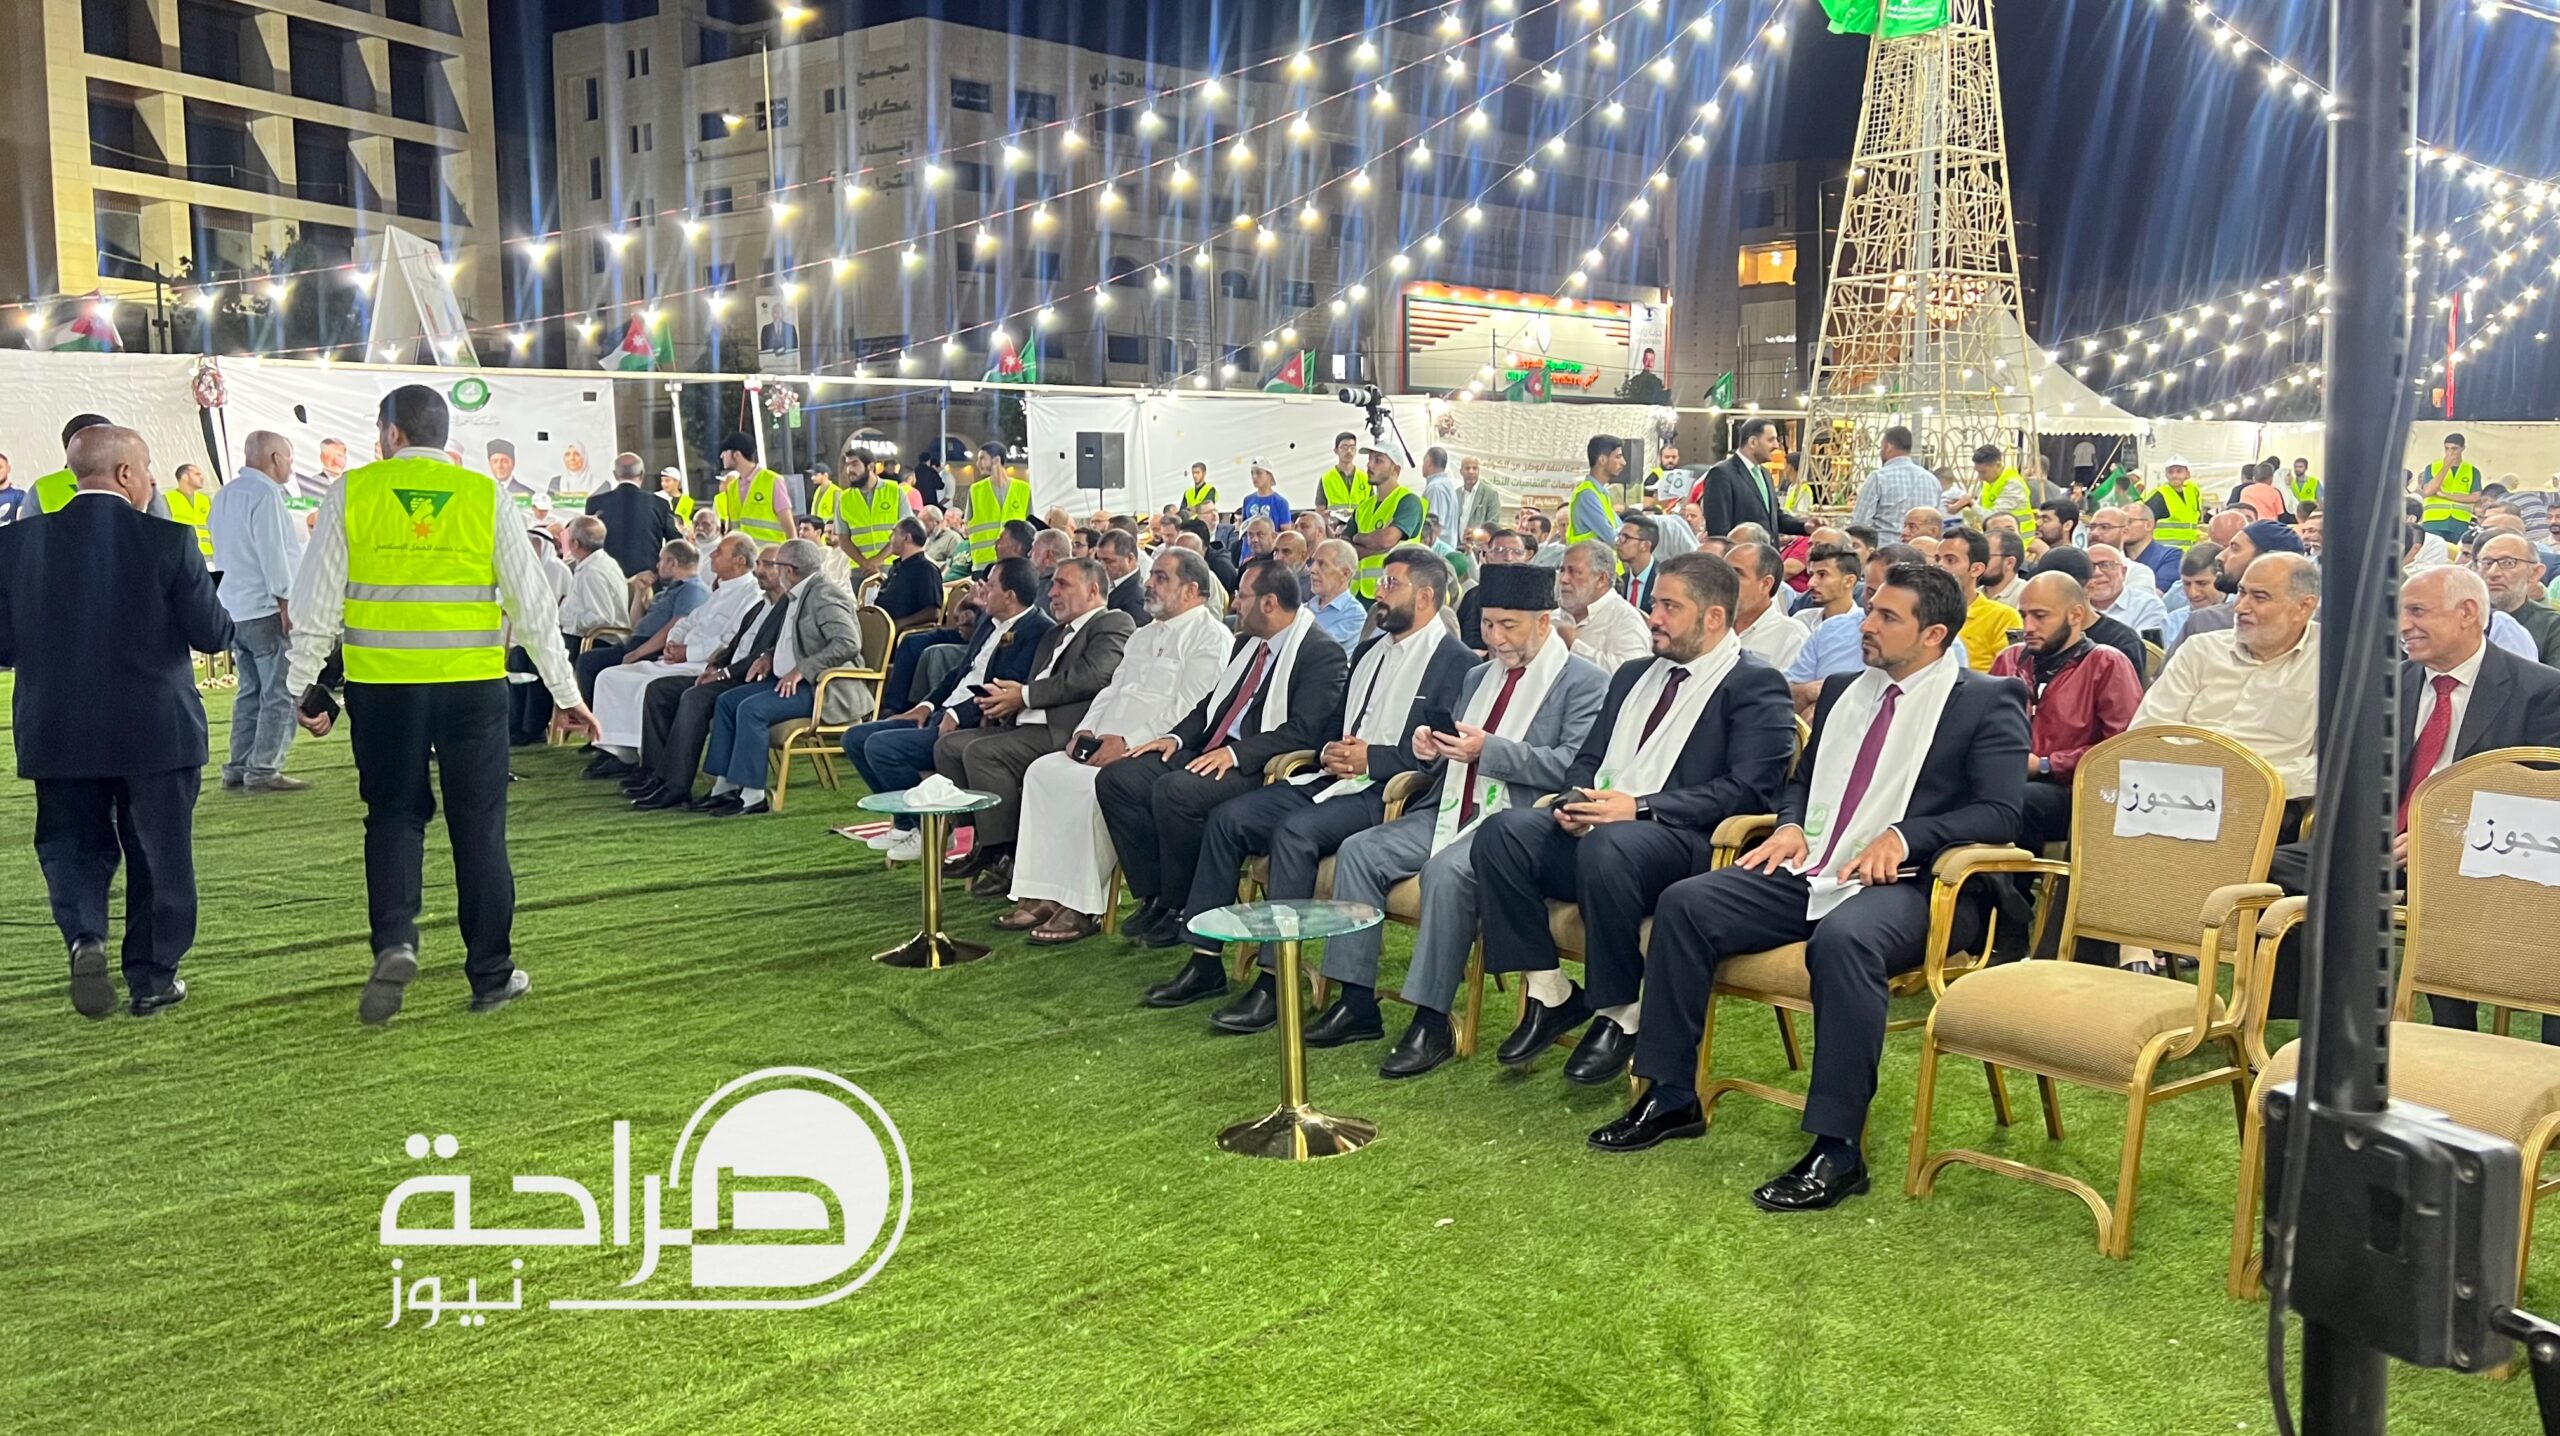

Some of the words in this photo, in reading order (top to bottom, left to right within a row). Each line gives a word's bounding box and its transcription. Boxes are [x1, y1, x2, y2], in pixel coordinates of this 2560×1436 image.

[857, 62, 910, 86] مجمع
[858, 98, 912, 126] عكاوي
[2122, 783, 2215, 816] محجوز
[2471, 818, 2560, 858] حجوز
